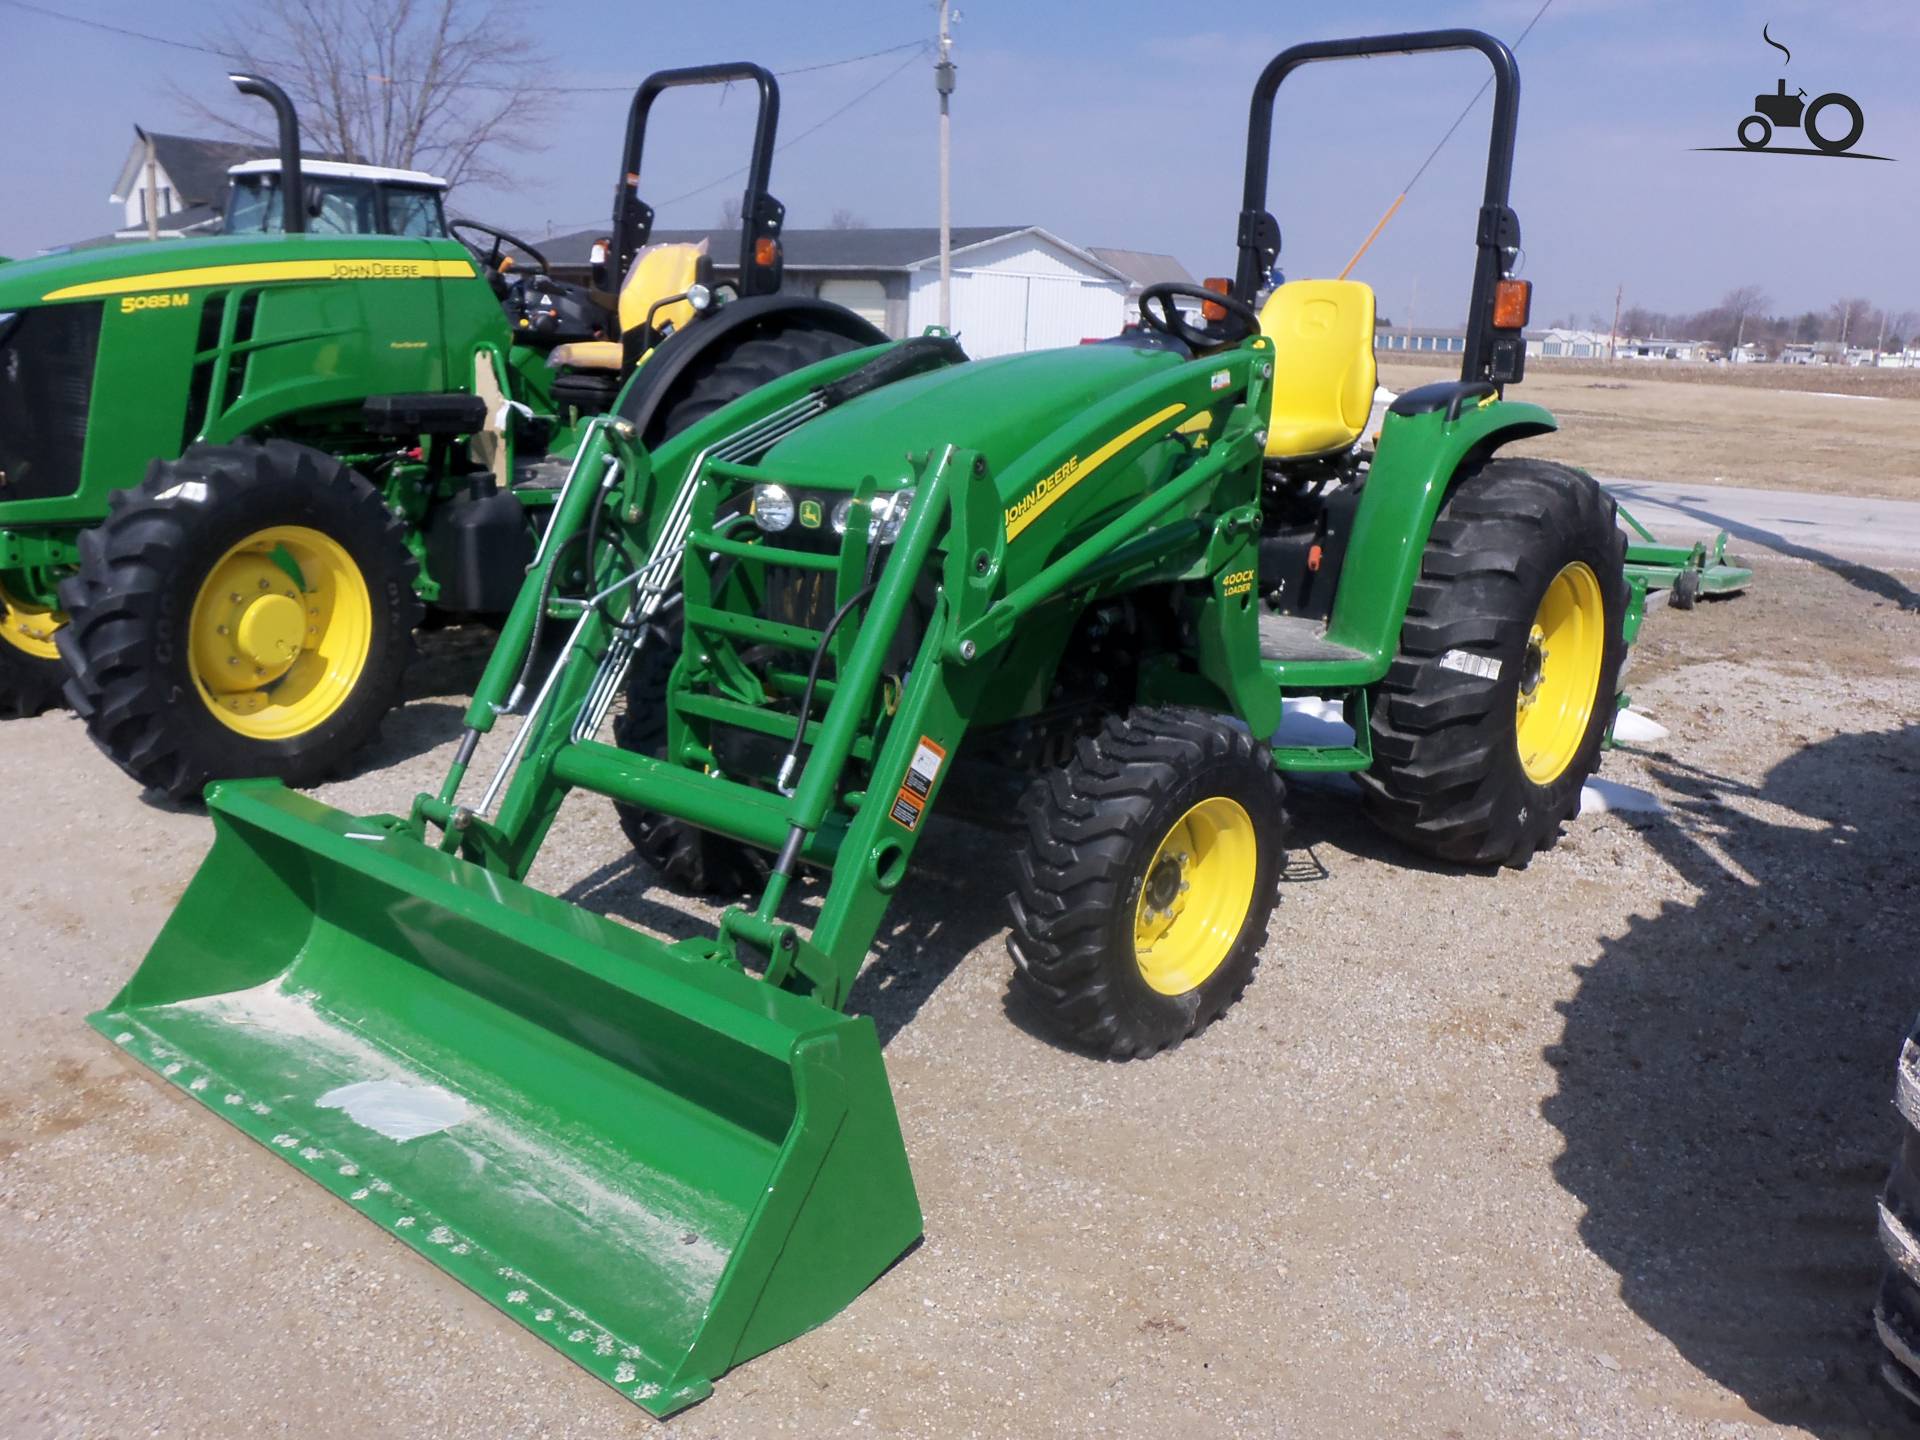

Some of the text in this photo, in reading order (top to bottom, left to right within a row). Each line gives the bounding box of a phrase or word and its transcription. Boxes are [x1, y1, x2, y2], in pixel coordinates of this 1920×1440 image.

[330, 262, 419, 279] JOHN DEERE
[1004, 455, 1079, 527] JOHN DEERE
[1222, 569, 1255, 585] 400CX
[1224, 583, 1251, 597] LOADER
